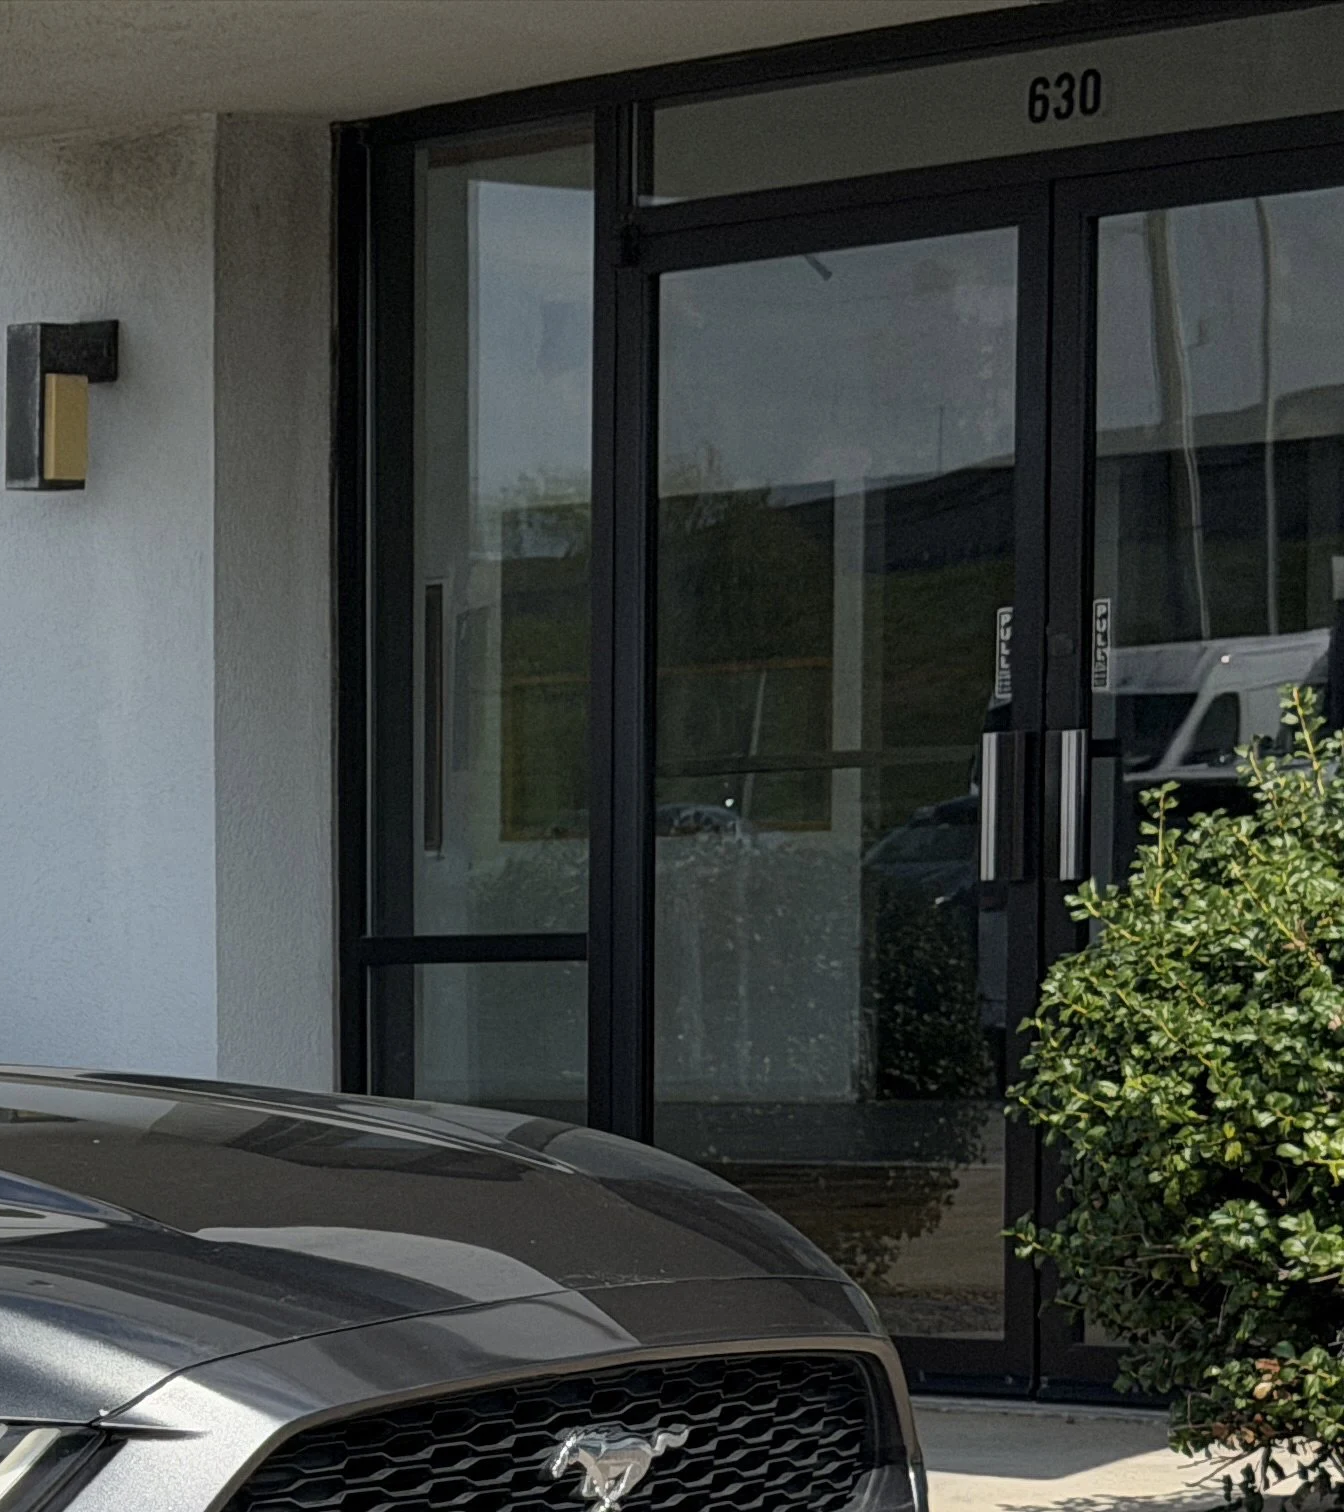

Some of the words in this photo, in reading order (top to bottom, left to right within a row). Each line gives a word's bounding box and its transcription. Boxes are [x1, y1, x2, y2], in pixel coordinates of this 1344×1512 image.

[1028, 68, 1102, 124] 630
[1000, 613, 1012, 669] PULL
[1096, 604, 1107, 661] PULL
